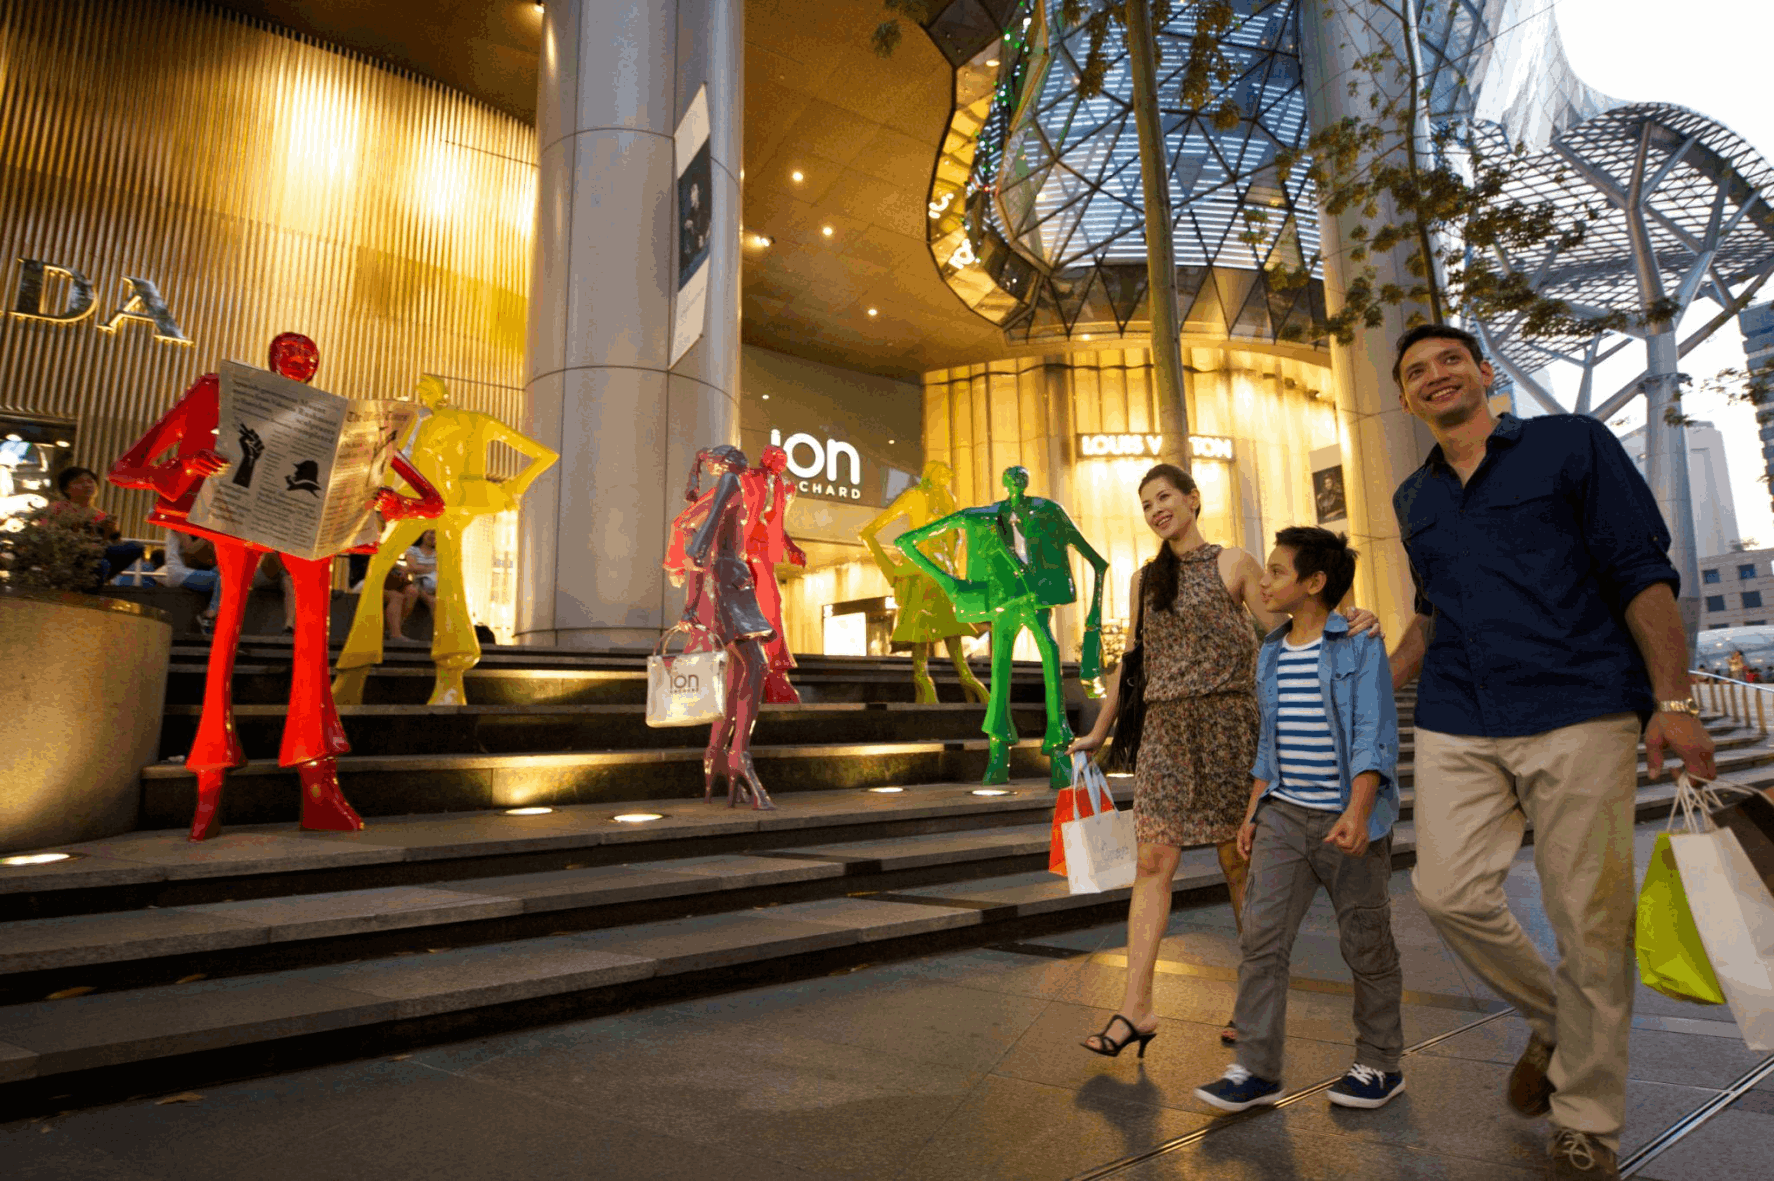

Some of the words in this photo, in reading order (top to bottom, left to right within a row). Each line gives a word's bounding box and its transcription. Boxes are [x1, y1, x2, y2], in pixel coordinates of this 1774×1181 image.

[1081, 434, 1144, 456] LOUIS
[1145, 434, 1233, 459] VTON
[798, 480, 861, 500] CHARD
